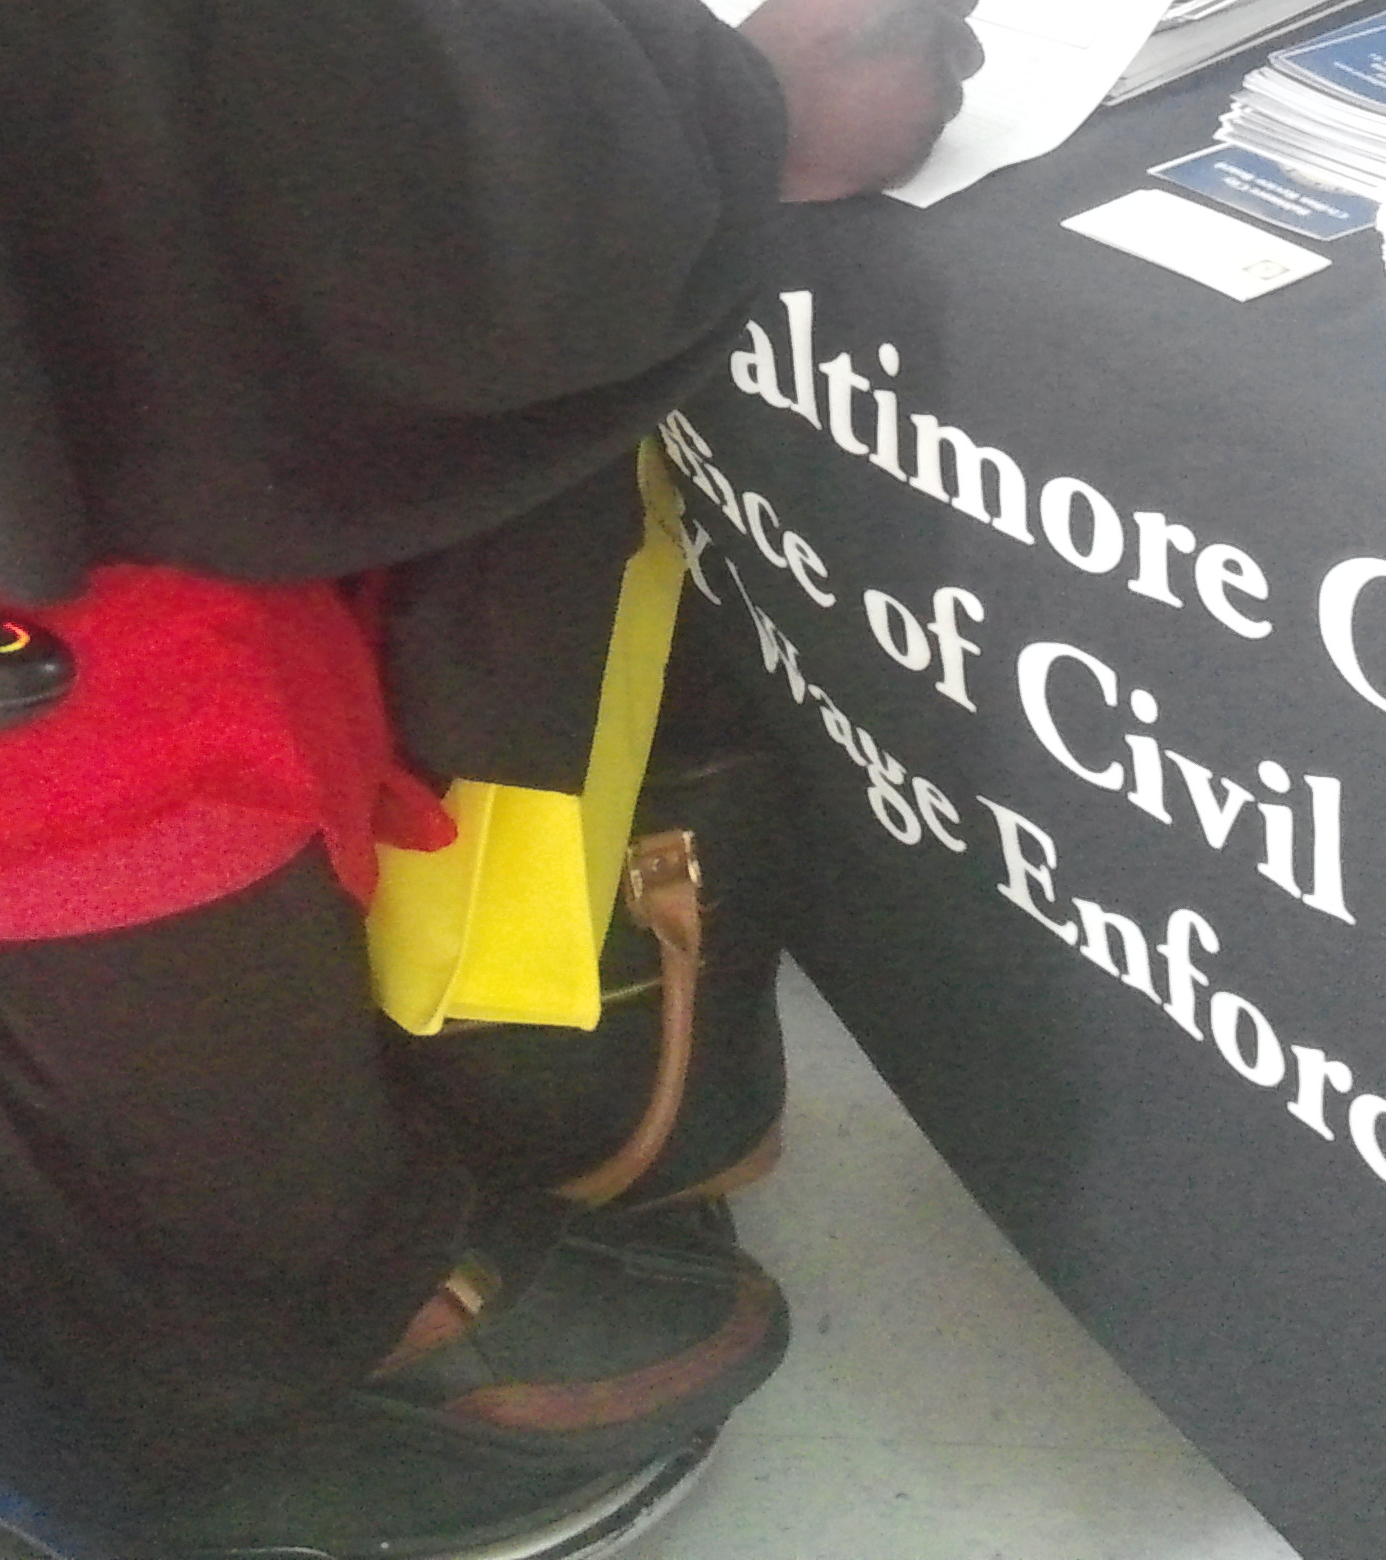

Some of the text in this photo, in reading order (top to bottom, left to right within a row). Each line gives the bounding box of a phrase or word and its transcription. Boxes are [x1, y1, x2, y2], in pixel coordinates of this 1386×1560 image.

[730, 290, 1273, 640] altimore
[658, 409, 837, 608] ffice
[863, 586, 985, 713] of
[1016, 641, 1357, 926] Civil
[725, 556, 967, 853] Wage
